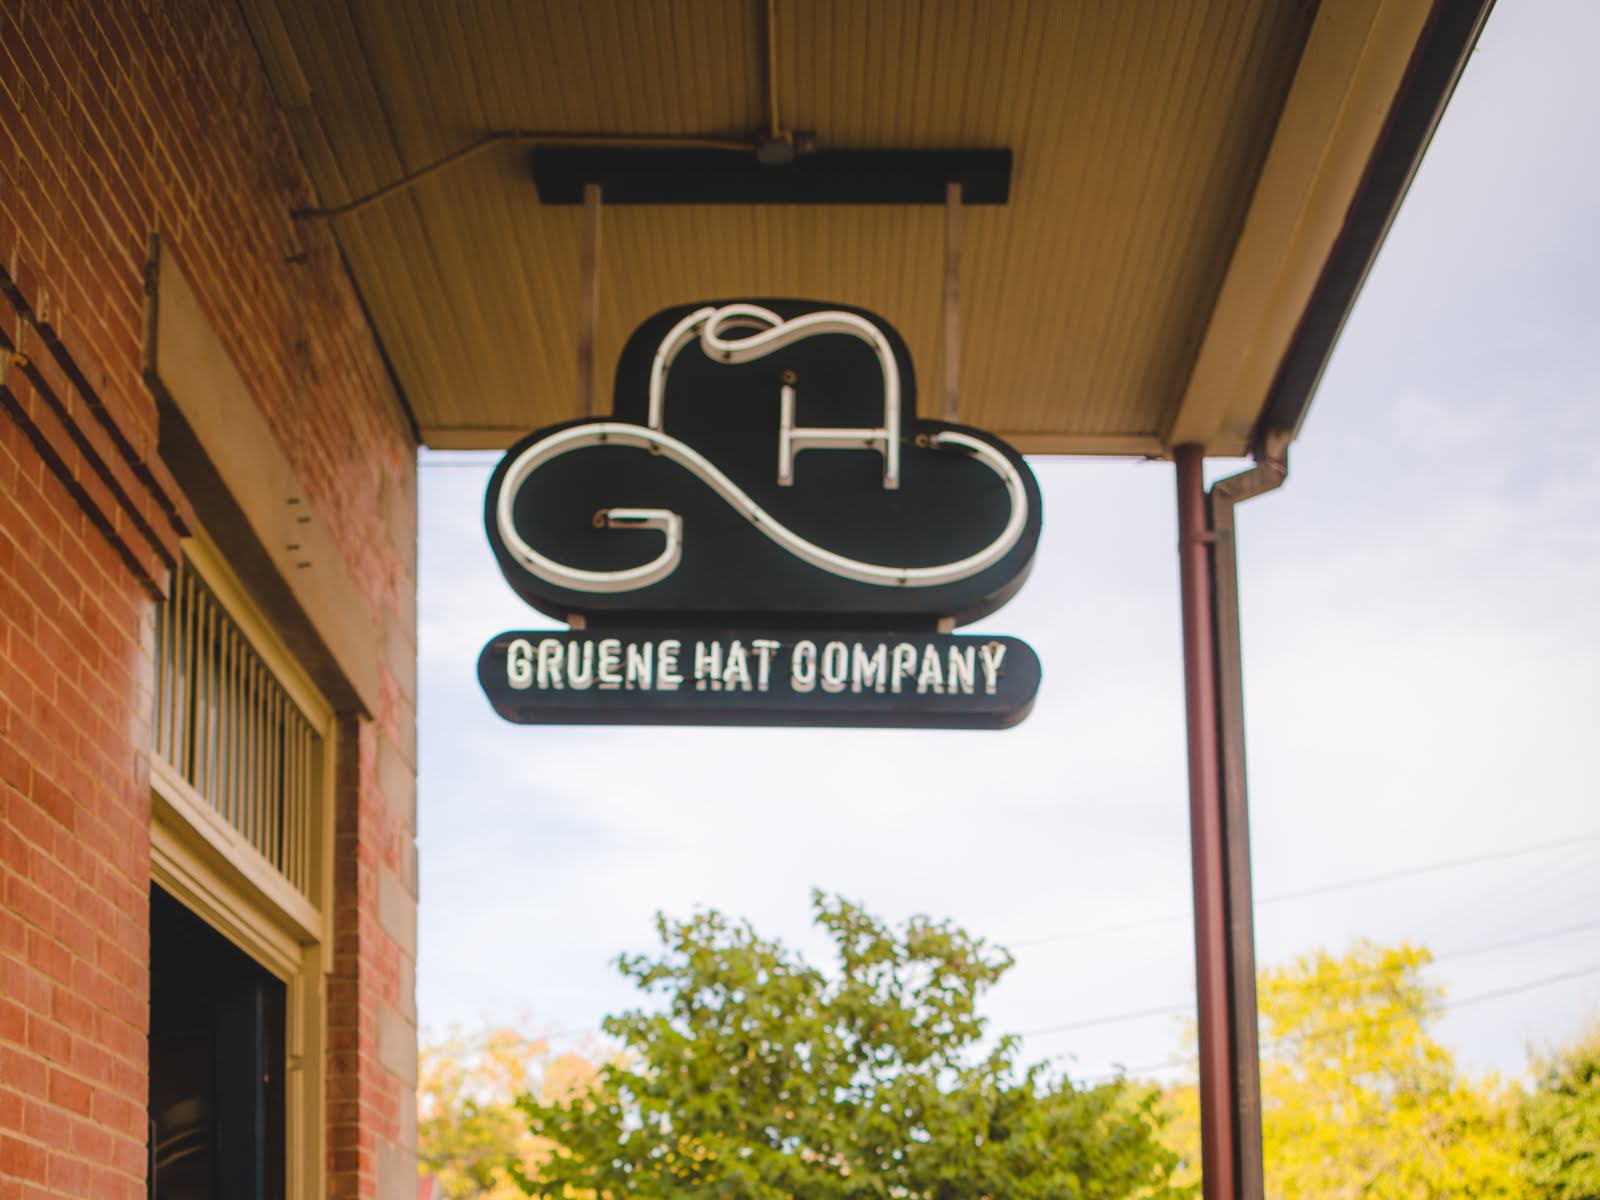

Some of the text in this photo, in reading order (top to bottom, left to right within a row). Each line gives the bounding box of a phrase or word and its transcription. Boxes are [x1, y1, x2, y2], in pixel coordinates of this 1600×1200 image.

[506, 638, 1007, 695] GRUENE HAT COMPANY
